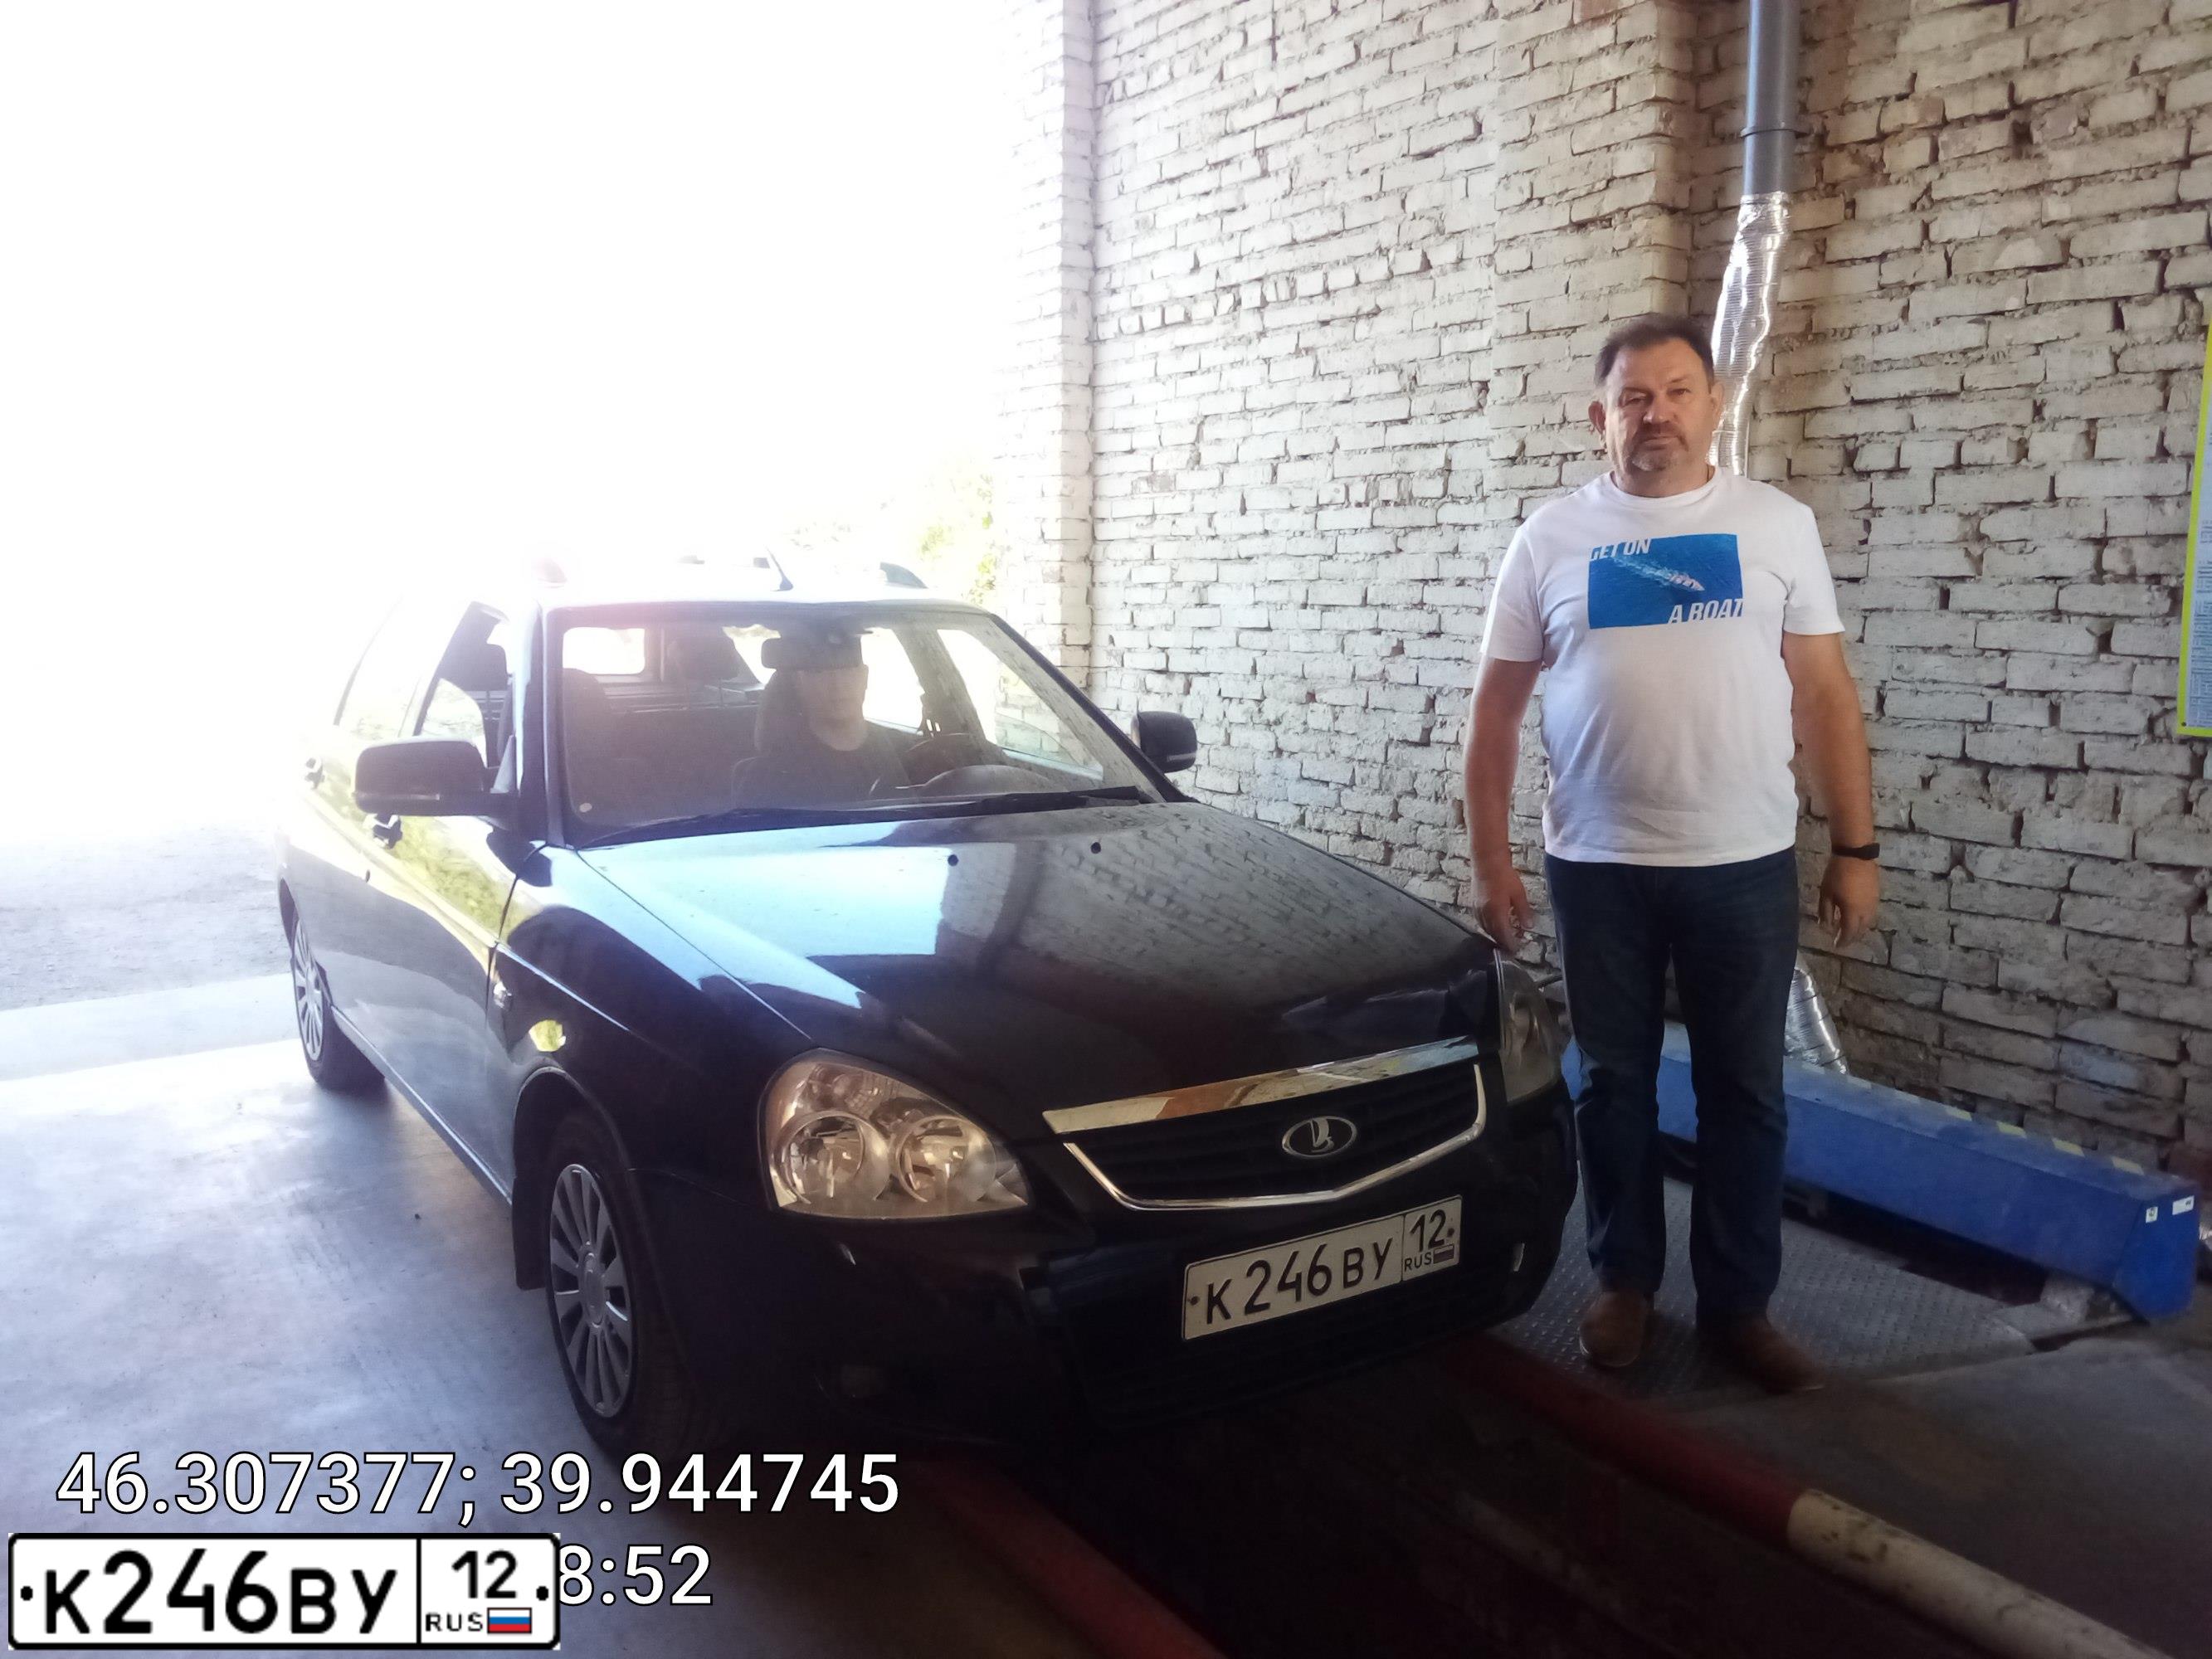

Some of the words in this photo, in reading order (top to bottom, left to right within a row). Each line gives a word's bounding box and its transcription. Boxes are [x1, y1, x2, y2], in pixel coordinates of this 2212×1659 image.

[1623, 538, 1651, 556] ON
[1668, 604, 1683, 624] A
[1688, 598, 1744, 623] BOAT
[1410, 1209, 1446, 1253] 12
[1404, 1249, 1433, 1272] RUS
